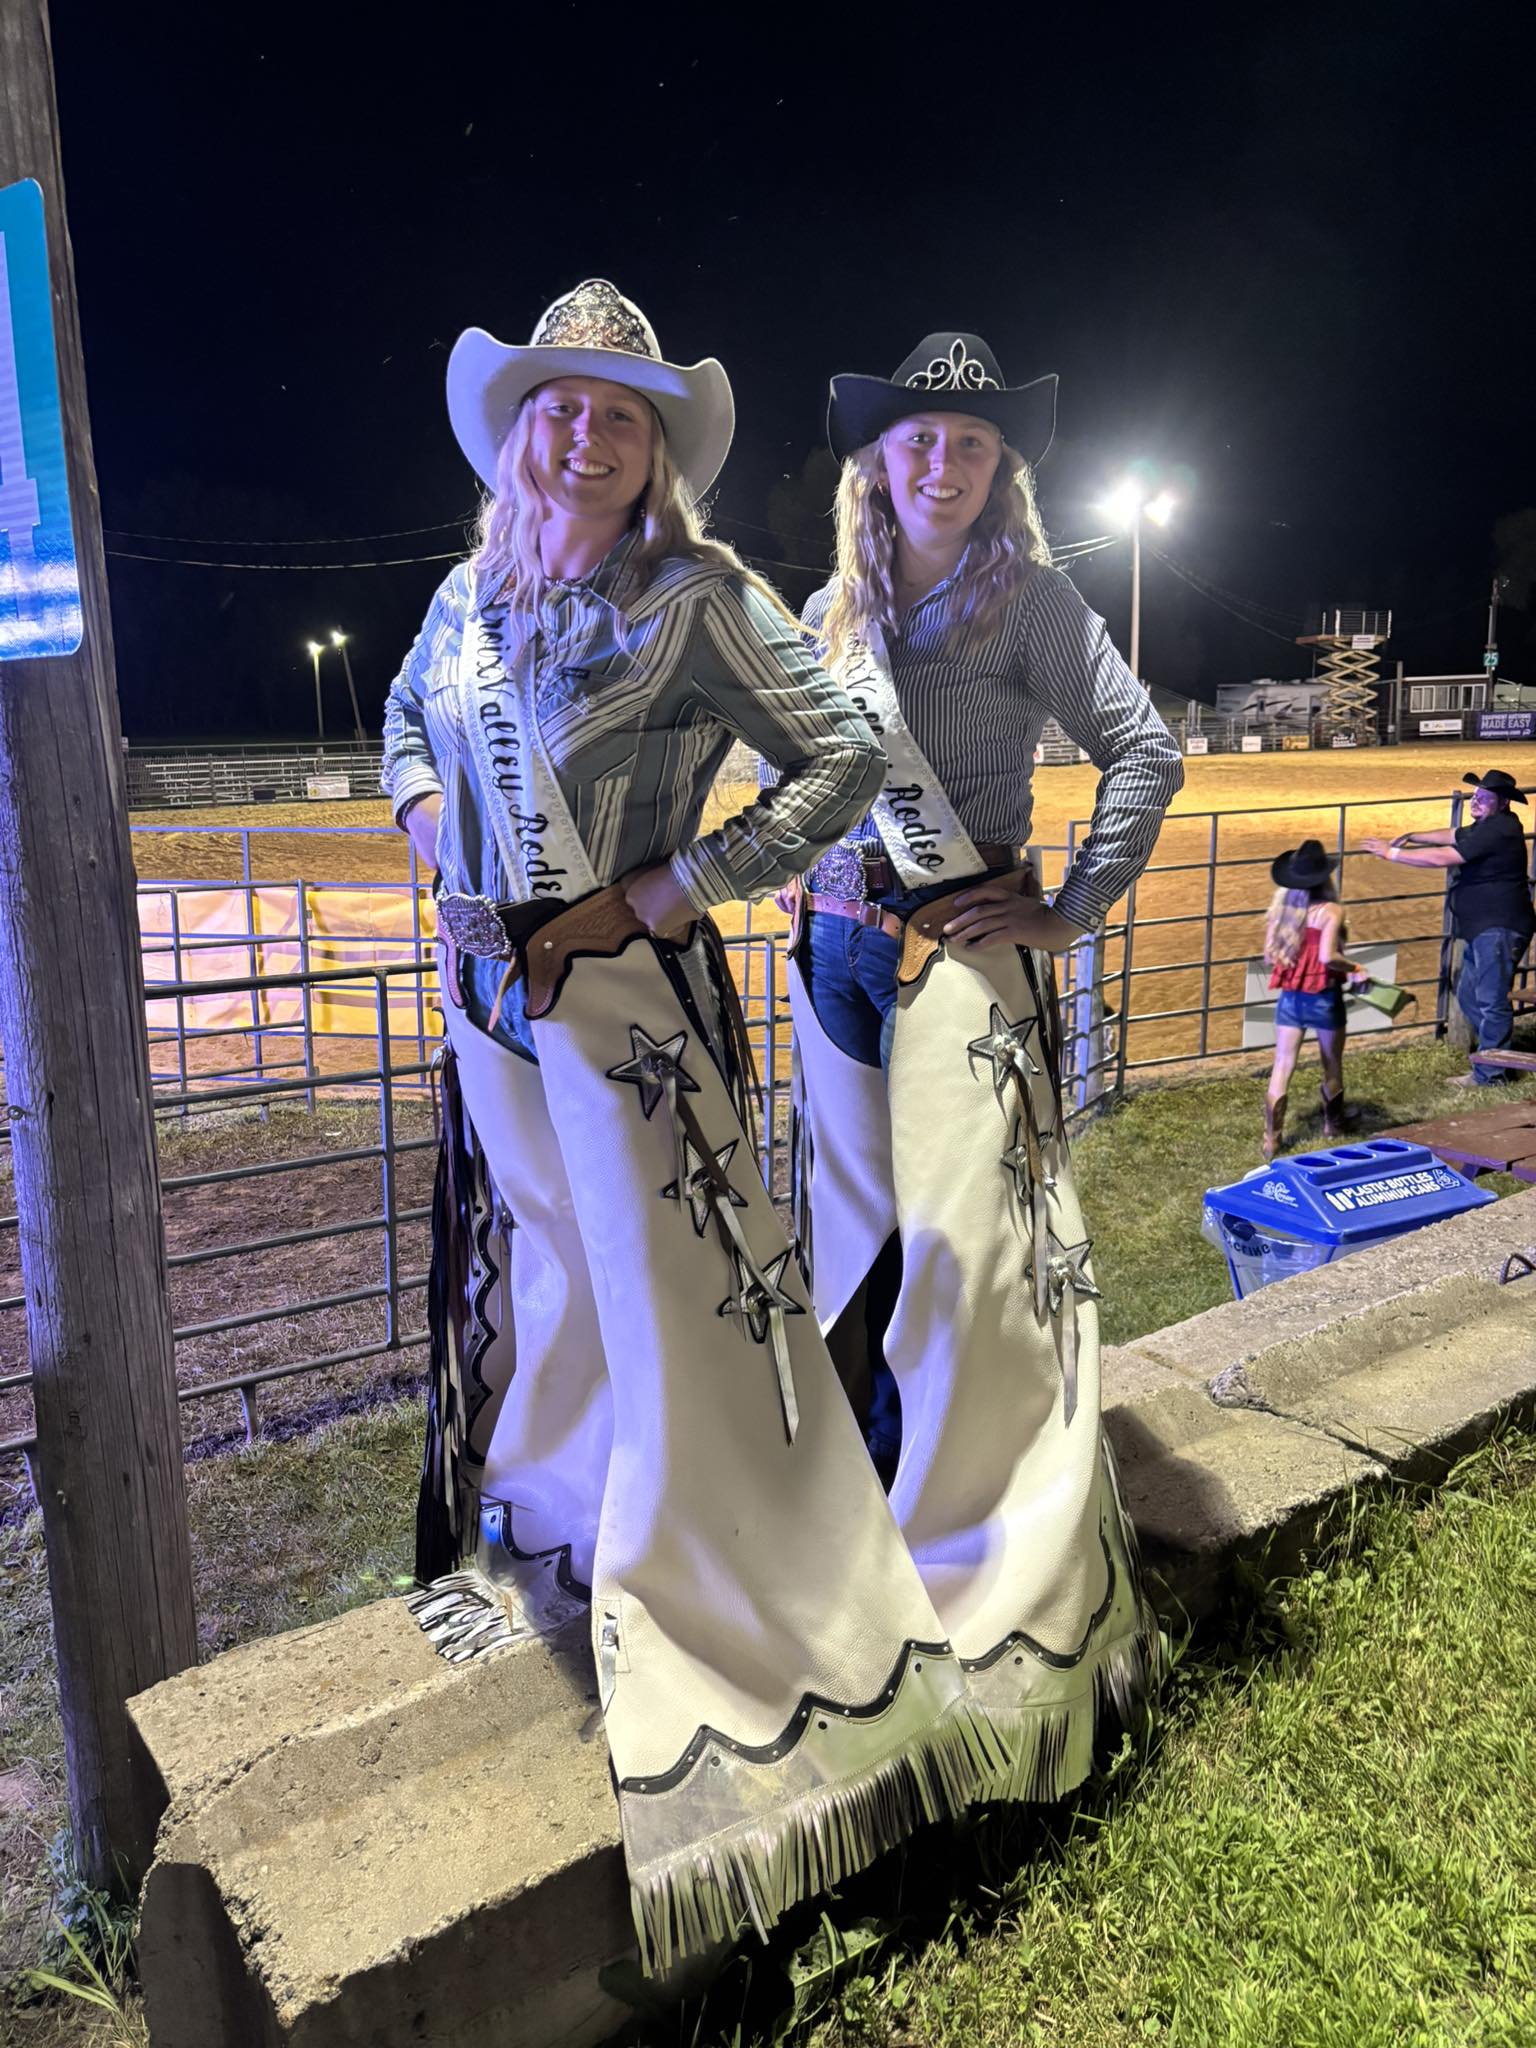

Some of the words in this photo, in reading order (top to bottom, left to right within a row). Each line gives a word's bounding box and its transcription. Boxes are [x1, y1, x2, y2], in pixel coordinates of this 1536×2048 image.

[1484, 653, 1498, 666] 25
[1481, 719, 1505, 730] MADE
[1508, 718, 1531, 729] EASY
[478, 668, 523, 801] Valley
[508, 804, 568, 900] Rode
[884, 780, 945, 873] Rodeo
[1343, 1181, 1389, 1198] PLASTIC
[1386, 1172, 1434, 1190] BOTTLES
[1355, 1188, 1413, 1207] ALUMINUM
[1410, 1181, 1440, 1195] CANS
